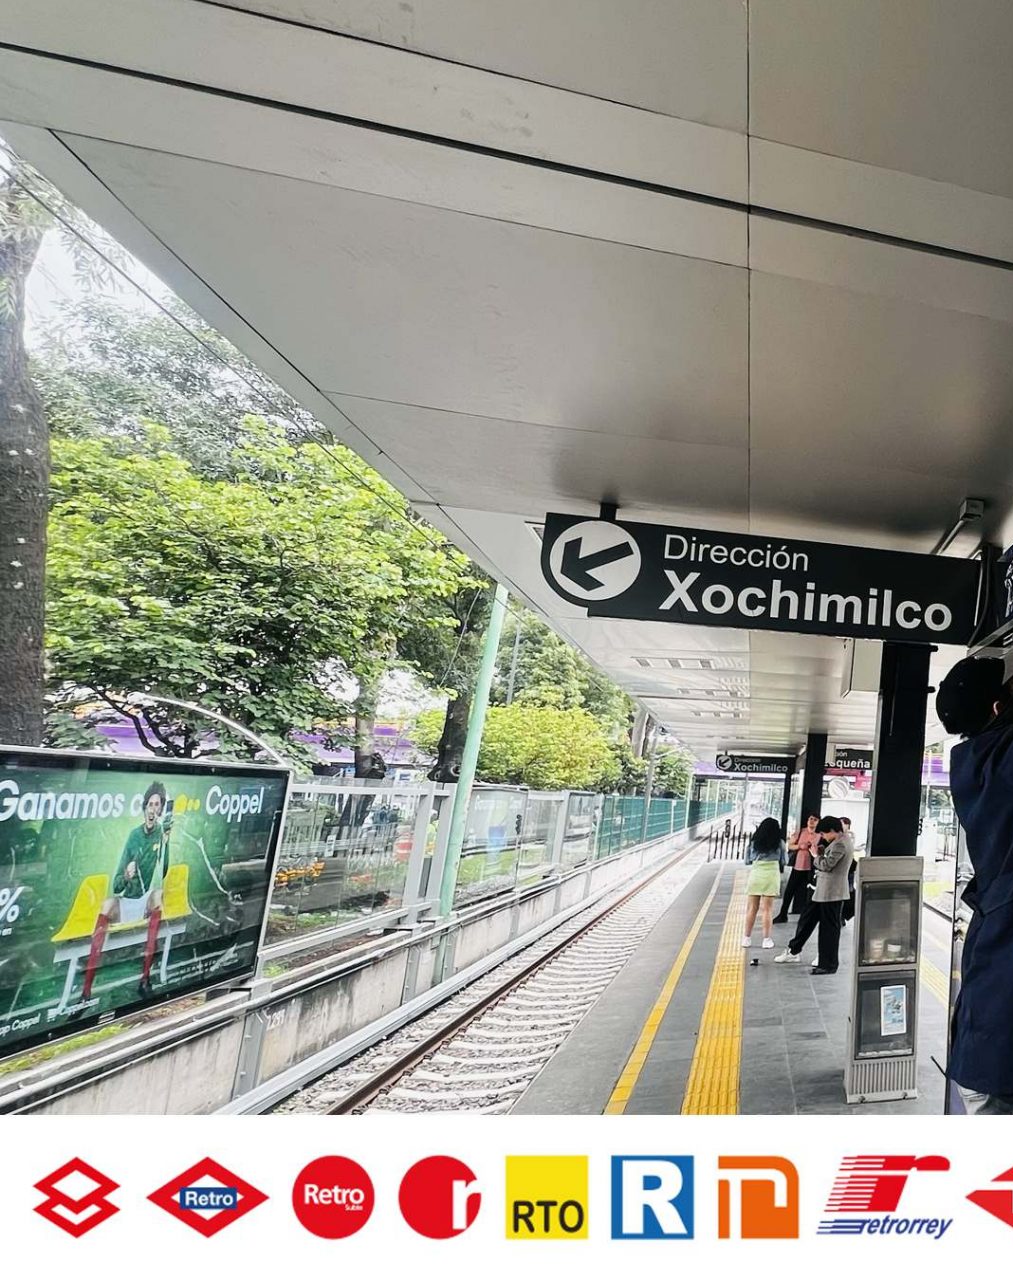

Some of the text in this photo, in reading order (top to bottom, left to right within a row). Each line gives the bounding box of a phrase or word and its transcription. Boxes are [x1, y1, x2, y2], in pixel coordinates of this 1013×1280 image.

[663, 533, 809, 572] Dirección
[658, 568, 952, 632] Xochimilco
[734, 763, 789, 772] Xochimilco
[0, 779, 126, 820] Ganamos
[205, 785, 265, 824] Coppel
[10, 1013, 41, 1033] Coppel
